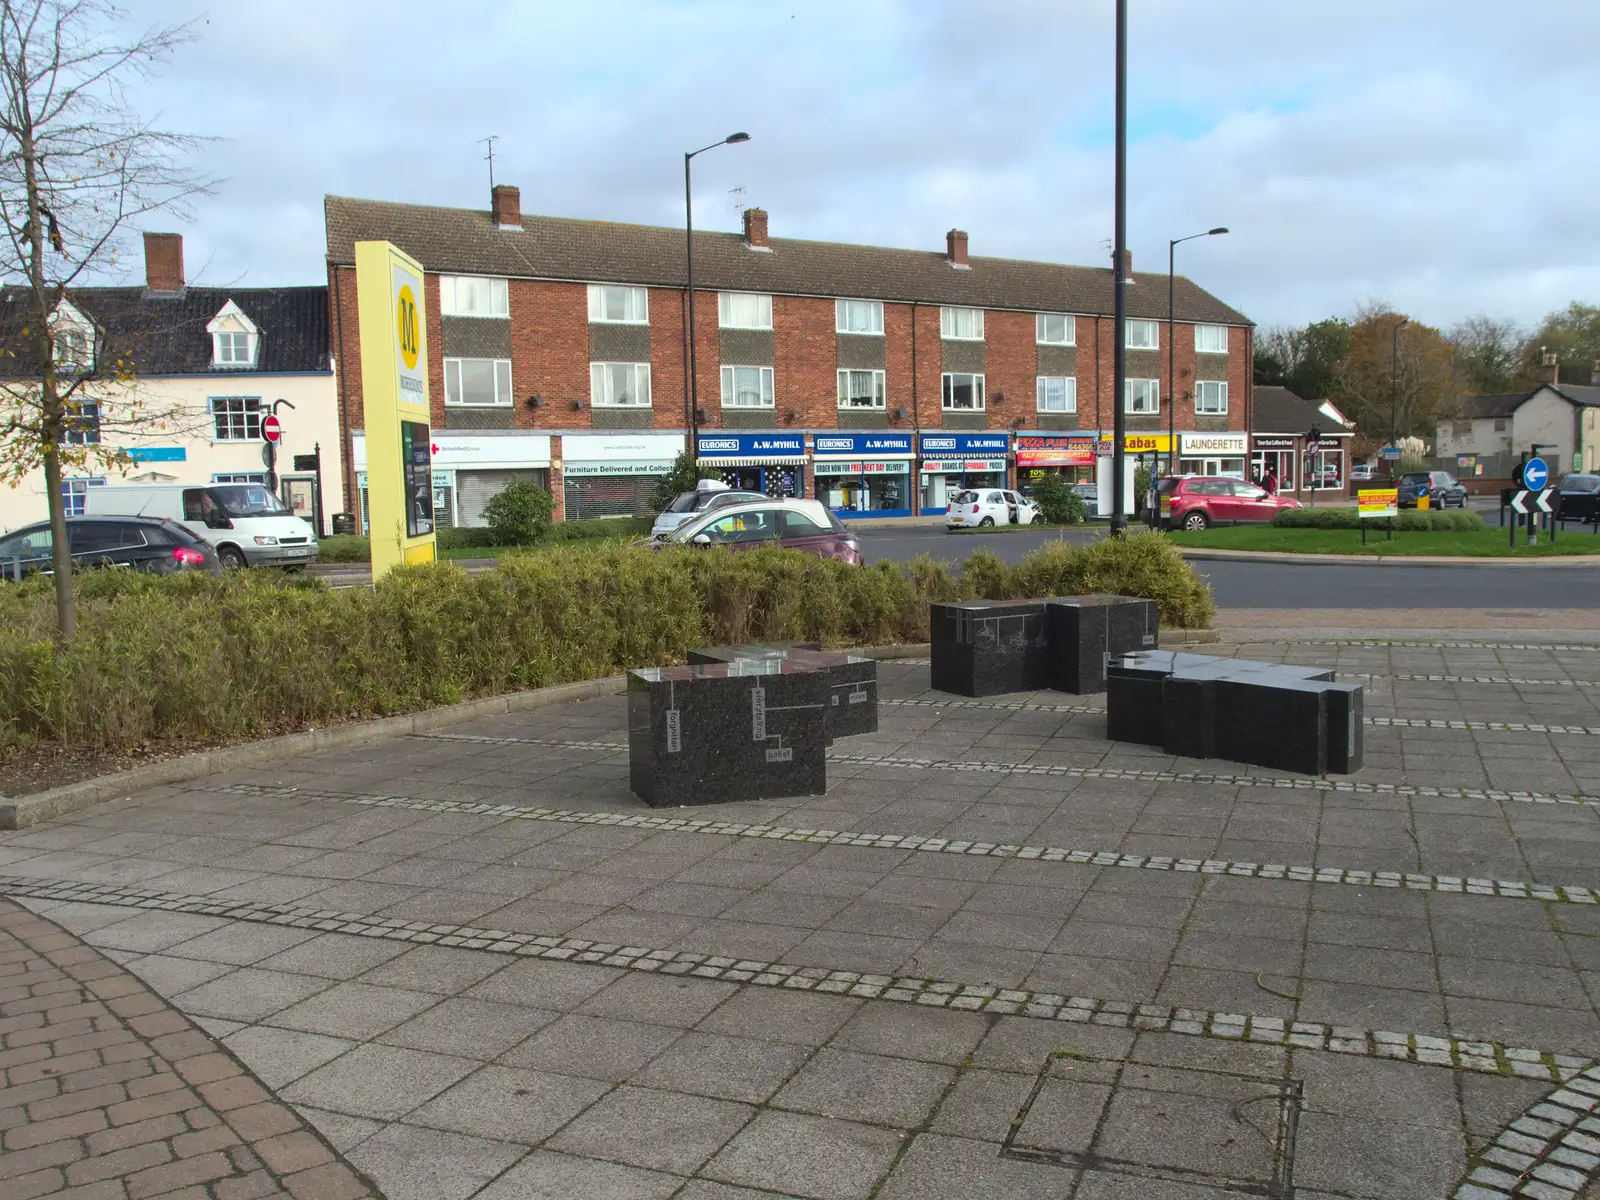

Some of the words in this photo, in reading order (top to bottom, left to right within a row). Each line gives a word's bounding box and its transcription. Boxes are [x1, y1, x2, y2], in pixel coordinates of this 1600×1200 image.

[401, 297, 416, 355] M
[701, 441, 737, 449] EURONICS
[753, 441, 800, 449] A.W.MYHILL
[819, 440, 851, 448] EURONICS
[865, 440, 908, 448] A.W.MYHILL
[925, 440, 953, 448] EURONICS
[966, 440, 1005, 448] A.W.MYHILL
[1018, 437, 1045, 447] PIZZA
[1046, 438, 1067, 447] PLUS
[1185, 439, 1244, 449] LAUNDERETTE
[600, 465, 633, 473] Delivered
[816, 464, 830, 473] ORDER
[831, 464, 841, 472] NOW
[842, 464, 850, 472] FOR
[851, 463, 862, 472] FREE
[863, 463, 875, 472] NEXT
[876, 463, 885, 471] DAY
[885, 463, 904, 471] DELIVERY
[941, 462, 957, 470] BRANDS
[755, 690, 764, 739] storytelling
[669, 712, 679, 750] forgotten
[768, 748, 790, 759] belief
